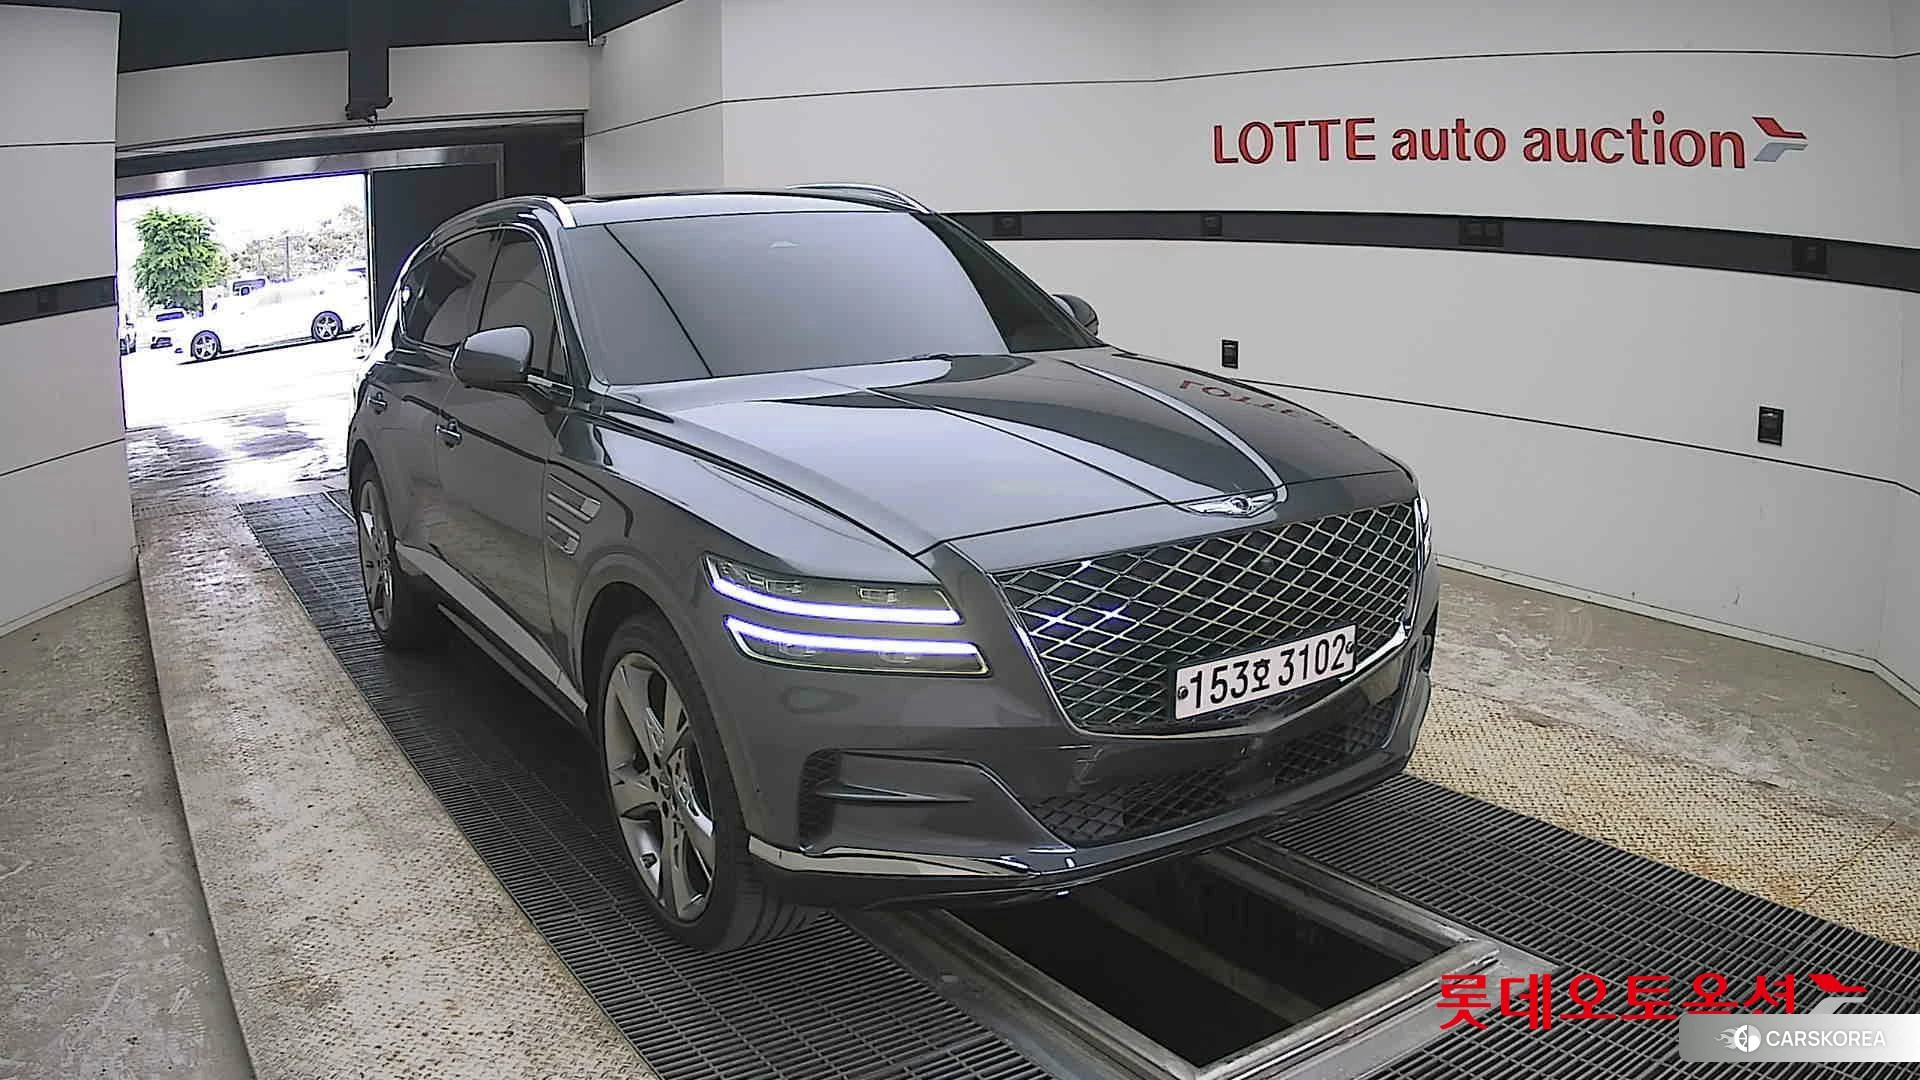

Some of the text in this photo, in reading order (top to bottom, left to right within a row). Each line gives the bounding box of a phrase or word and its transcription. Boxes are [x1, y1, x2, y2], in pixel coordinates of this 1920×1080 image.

[1213, 111, 1746, 168] LOTTE auto auction
[1190, 633, 1347, 708] 153호 3102
